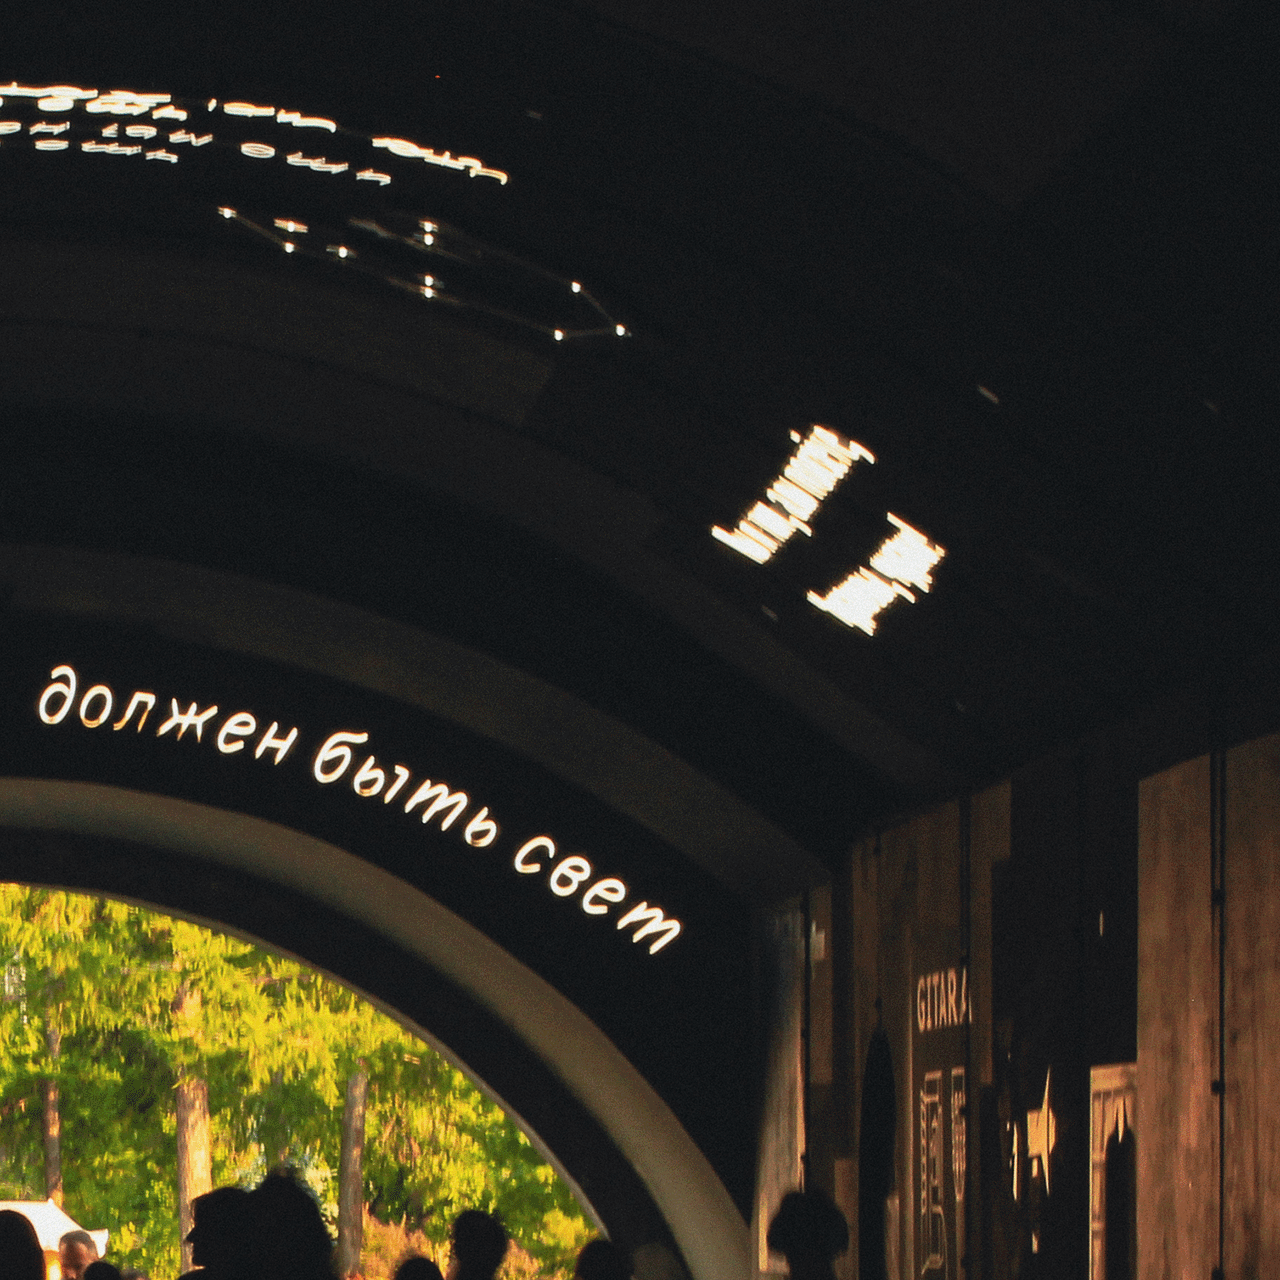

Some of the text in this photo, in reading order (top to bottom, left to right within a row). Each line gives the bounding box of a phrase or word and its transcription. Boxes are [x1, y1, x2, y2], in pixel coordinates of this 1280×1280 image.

[38, 664, 299, 766] должен
[313, 731, 498, 848] быть
[513, 835, 682, 955] свет
